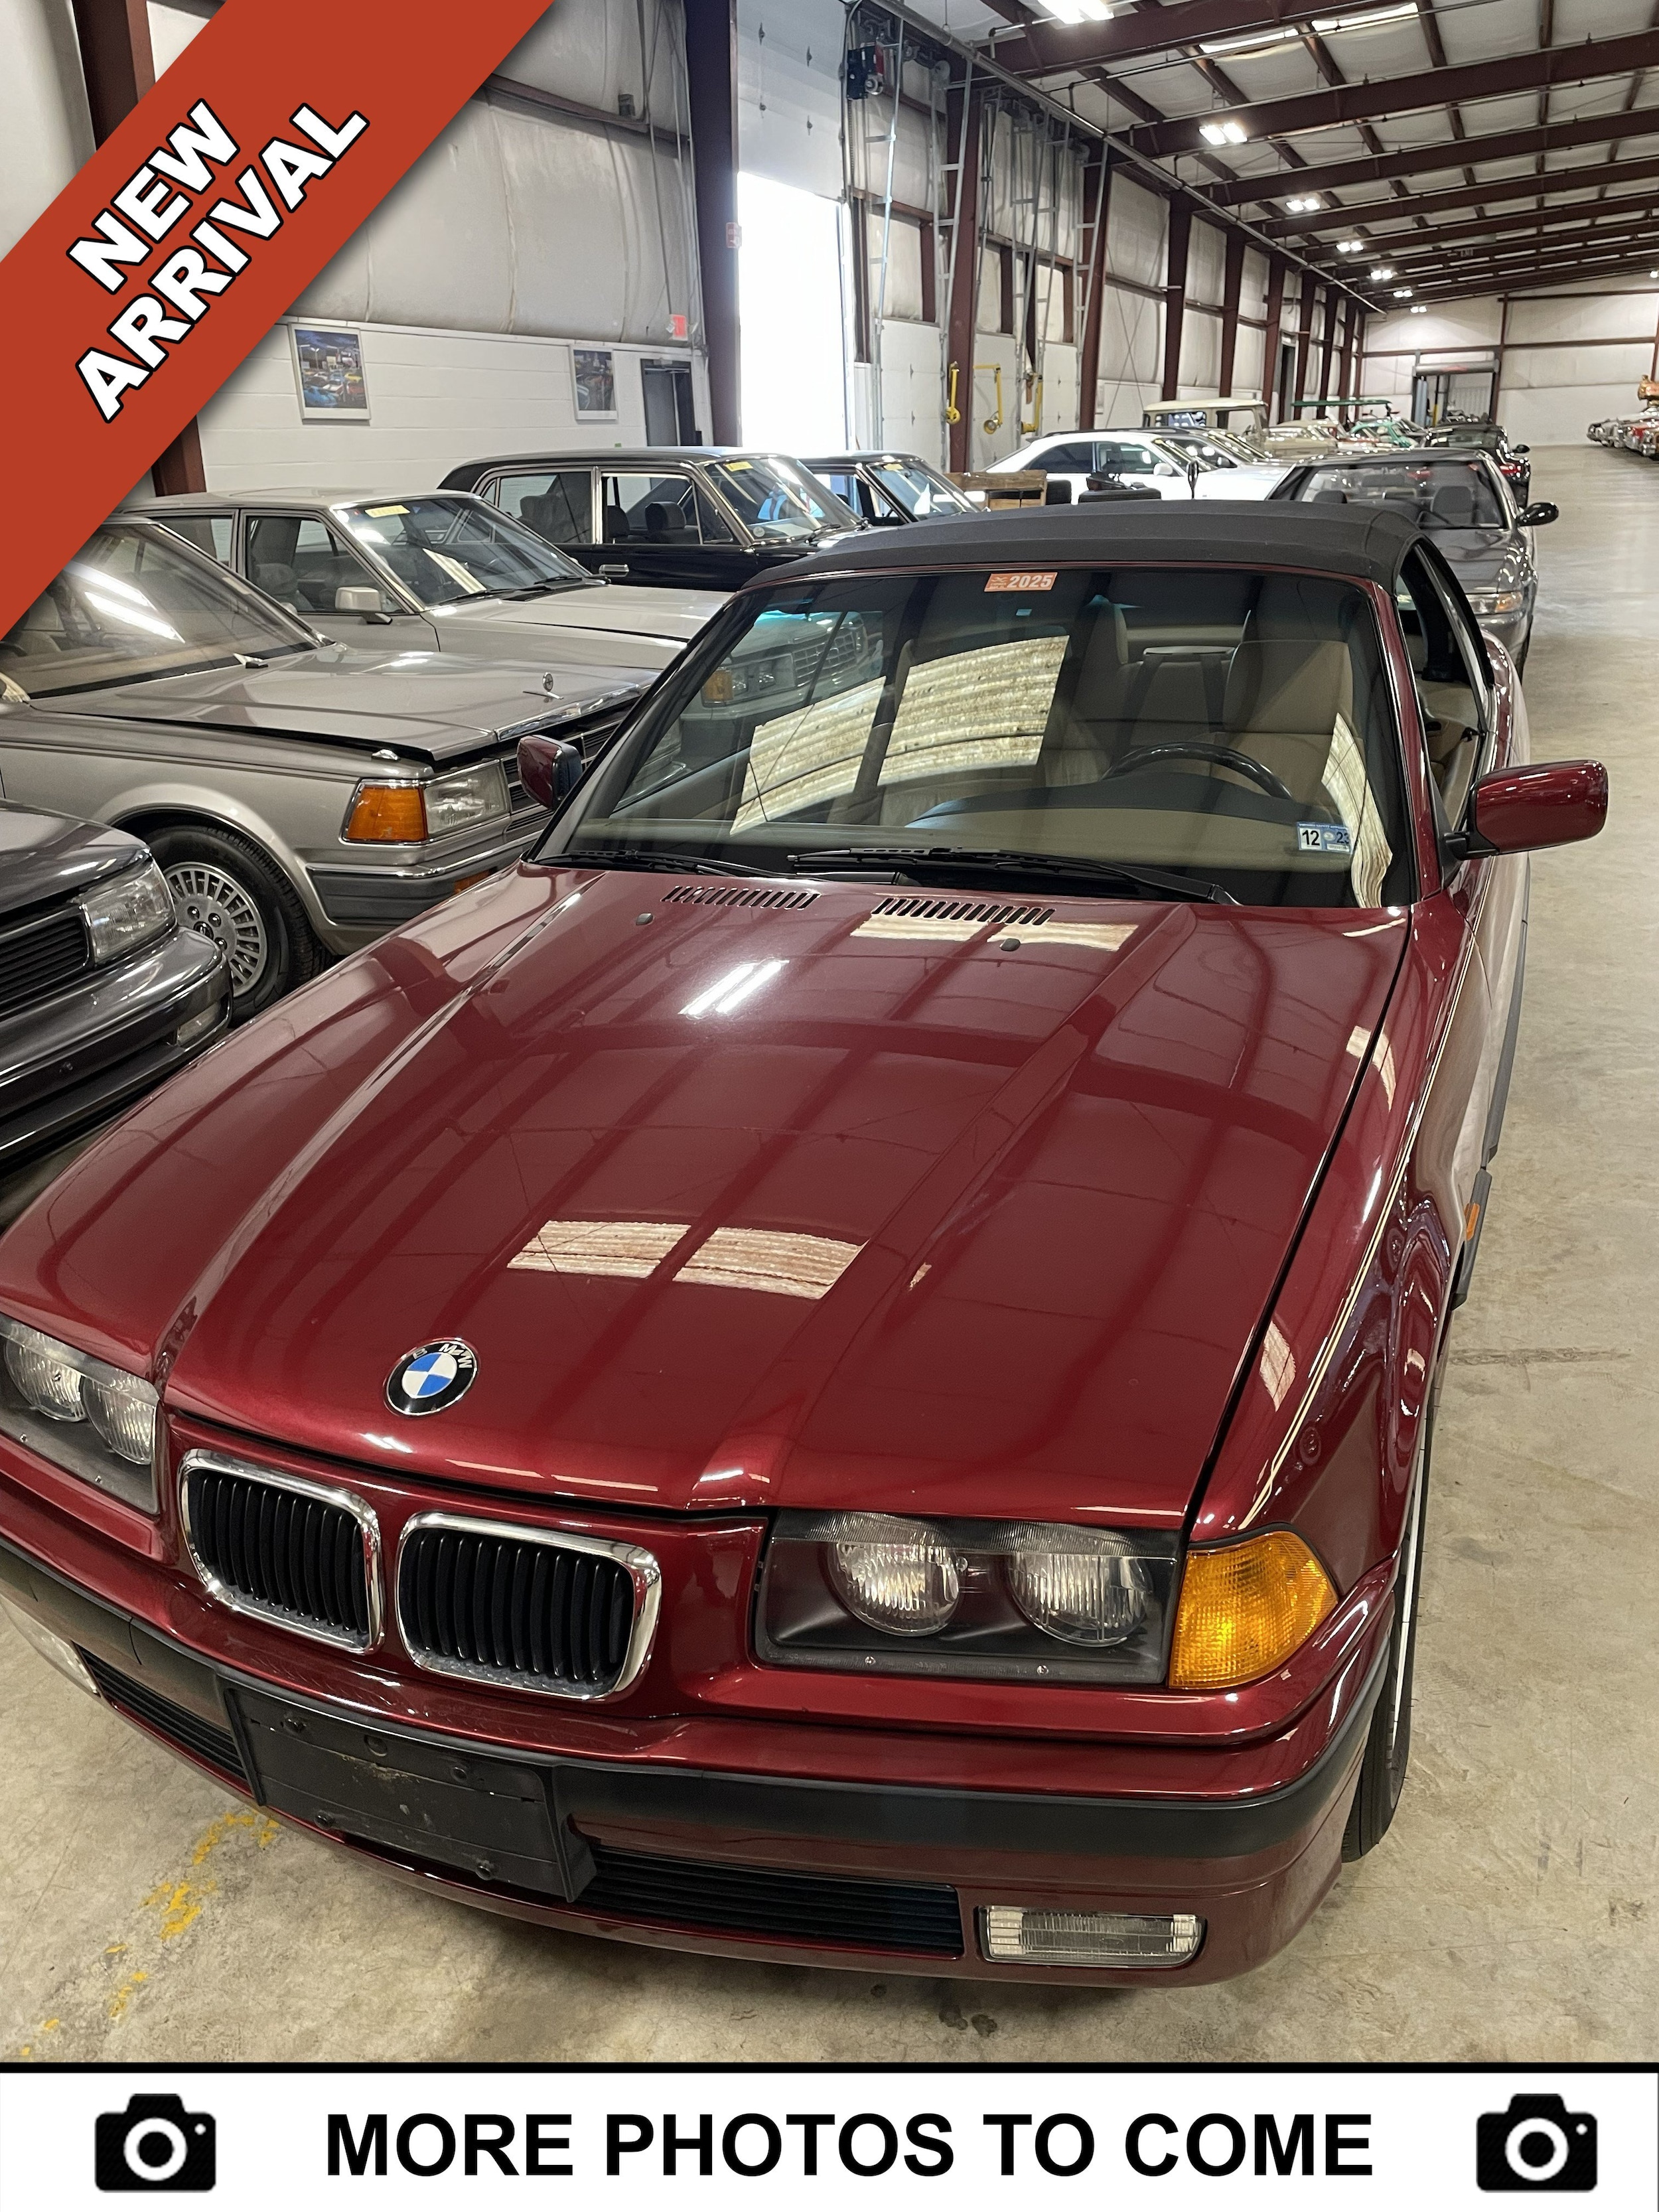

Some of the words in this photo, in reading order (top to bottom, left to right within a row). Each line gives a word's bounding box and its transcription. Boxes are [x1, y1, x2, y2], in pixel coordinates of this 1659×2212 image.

[1007, 575, 1054, 588] 2025
[1302, 830, 1321, 846] 12
[412, 1343, 472, 1368] BMW
